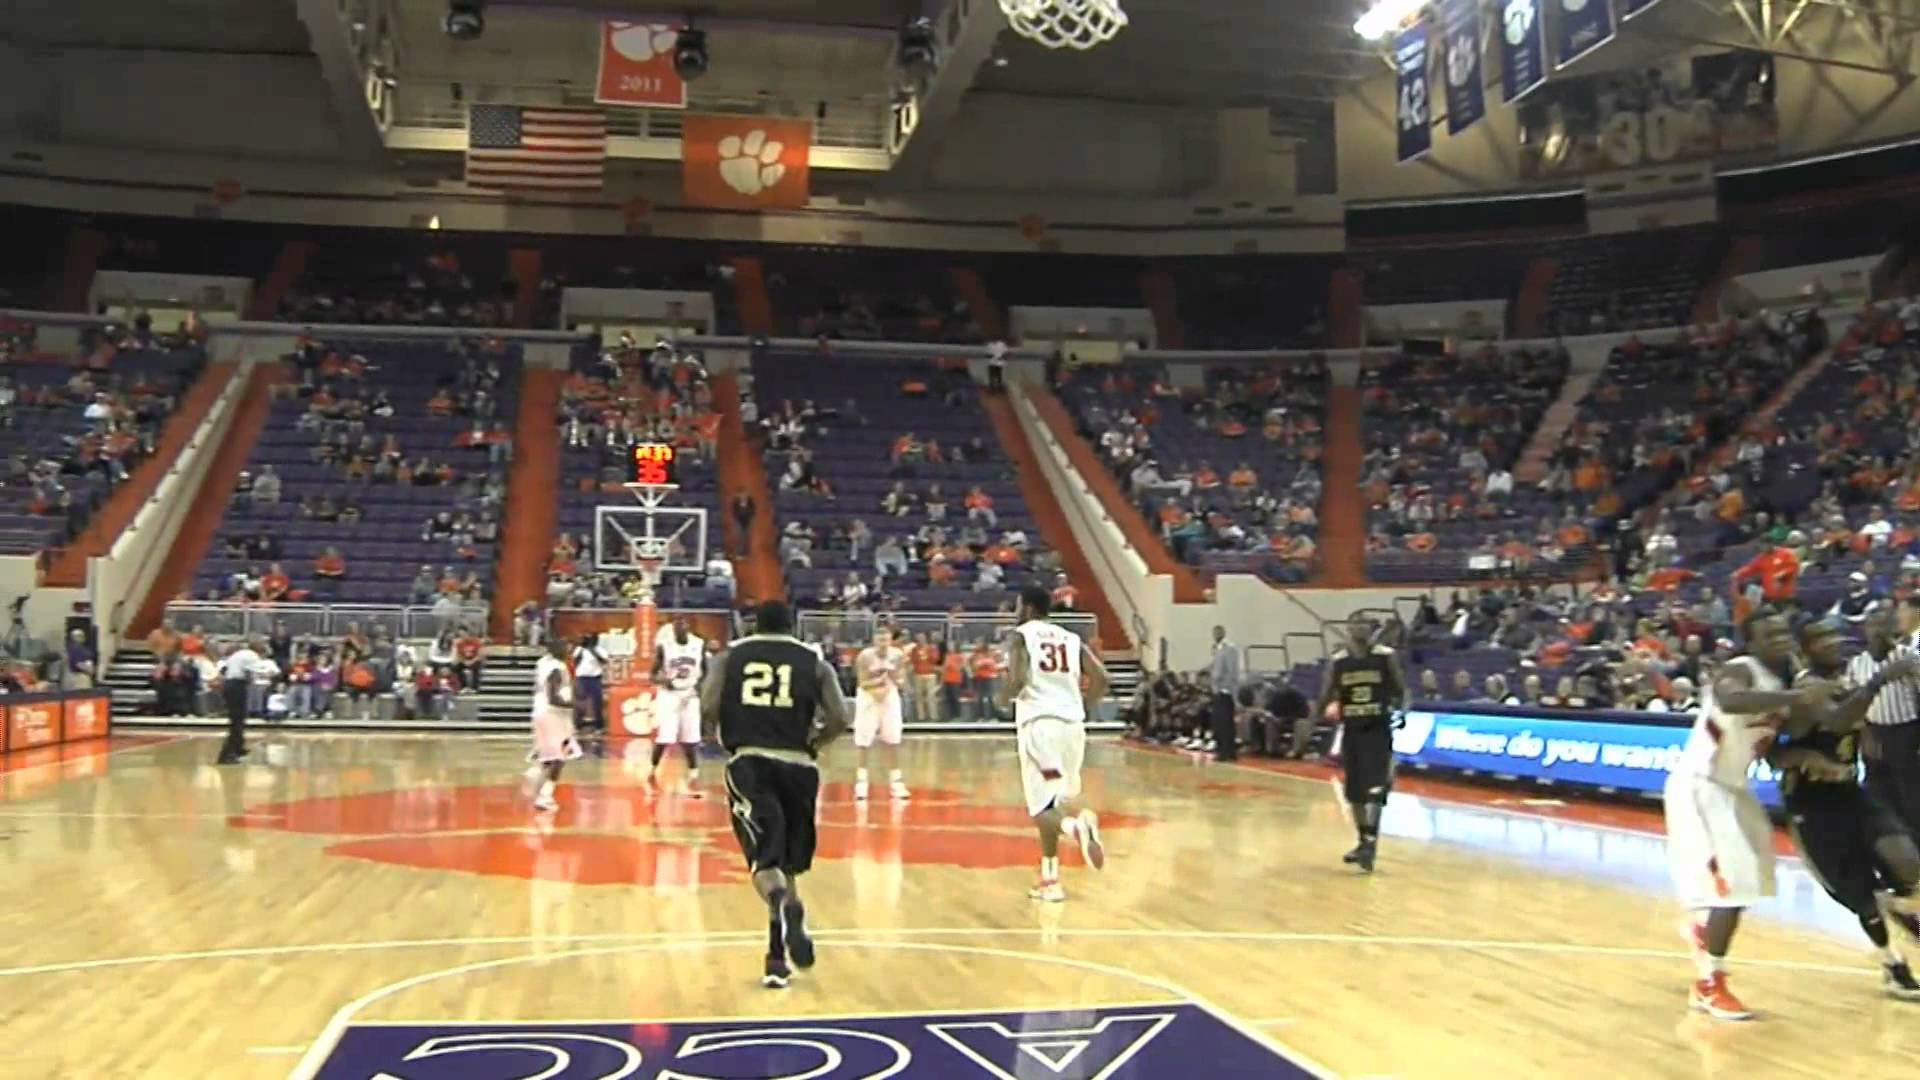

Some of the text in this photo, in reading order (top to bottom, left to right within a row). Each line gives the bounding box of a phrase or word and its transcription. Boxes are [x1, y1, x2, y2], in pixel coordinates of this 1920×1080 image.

[620, 75, 662, 93] 2011
[1039, 642, 1070, 673] 31
[742, 661, 794, 708] 21
[1435, 723, 1508, 755] Where
[1507, 729, 1545, 758] do
[1542, 737, 1600, 767] you
